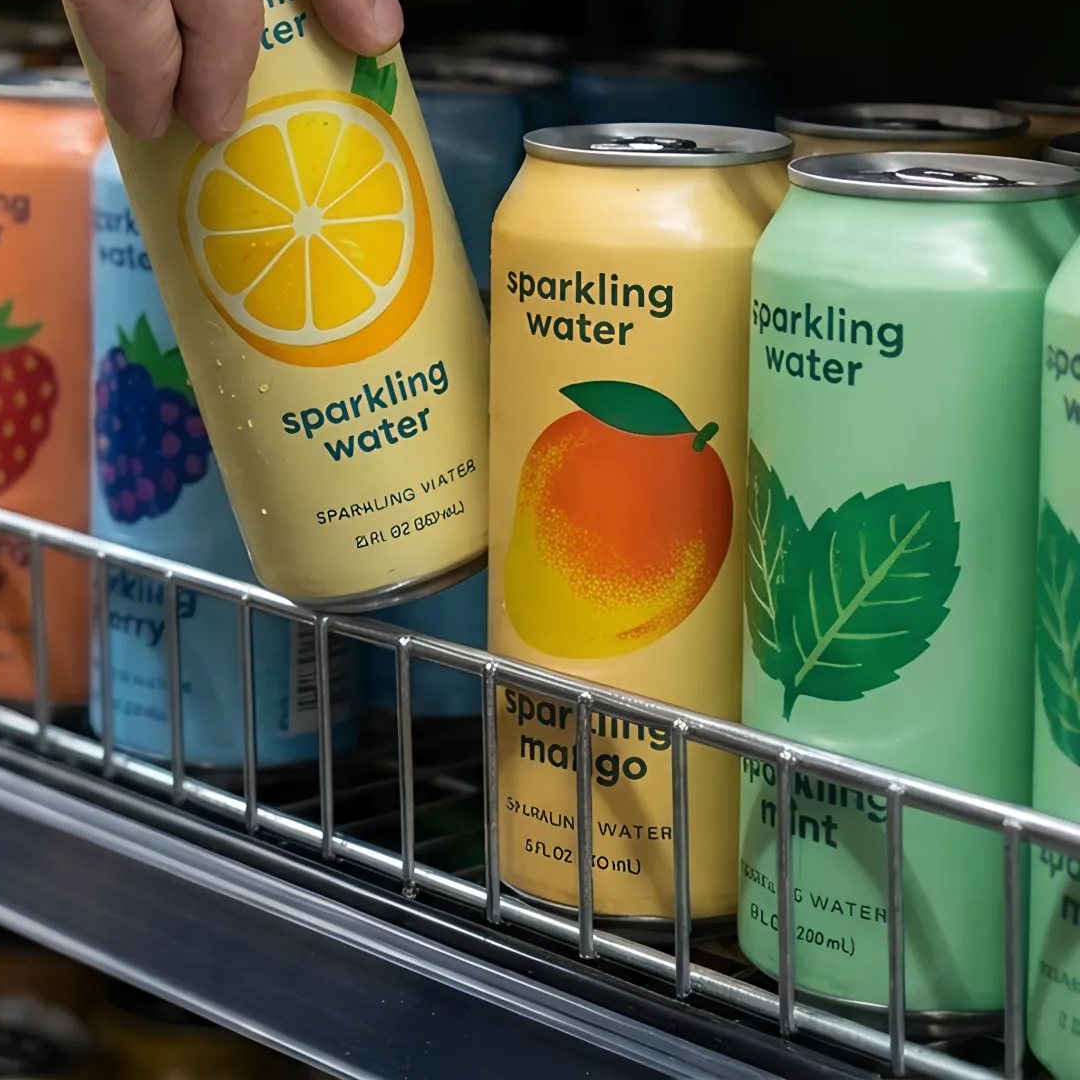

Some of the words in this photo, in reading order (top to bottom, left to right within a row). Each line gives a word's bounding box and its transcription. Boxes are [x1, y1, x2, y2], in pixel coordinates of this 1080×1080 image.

[506, 270, 674, 318] sparkling
[526, 311, 634, 346] water
[765, 345, 863, 387] water
[281, 360, 449, 439] sparkling
[323, 407, 430, 461] water
[598, 820, 673, 840] WATER
